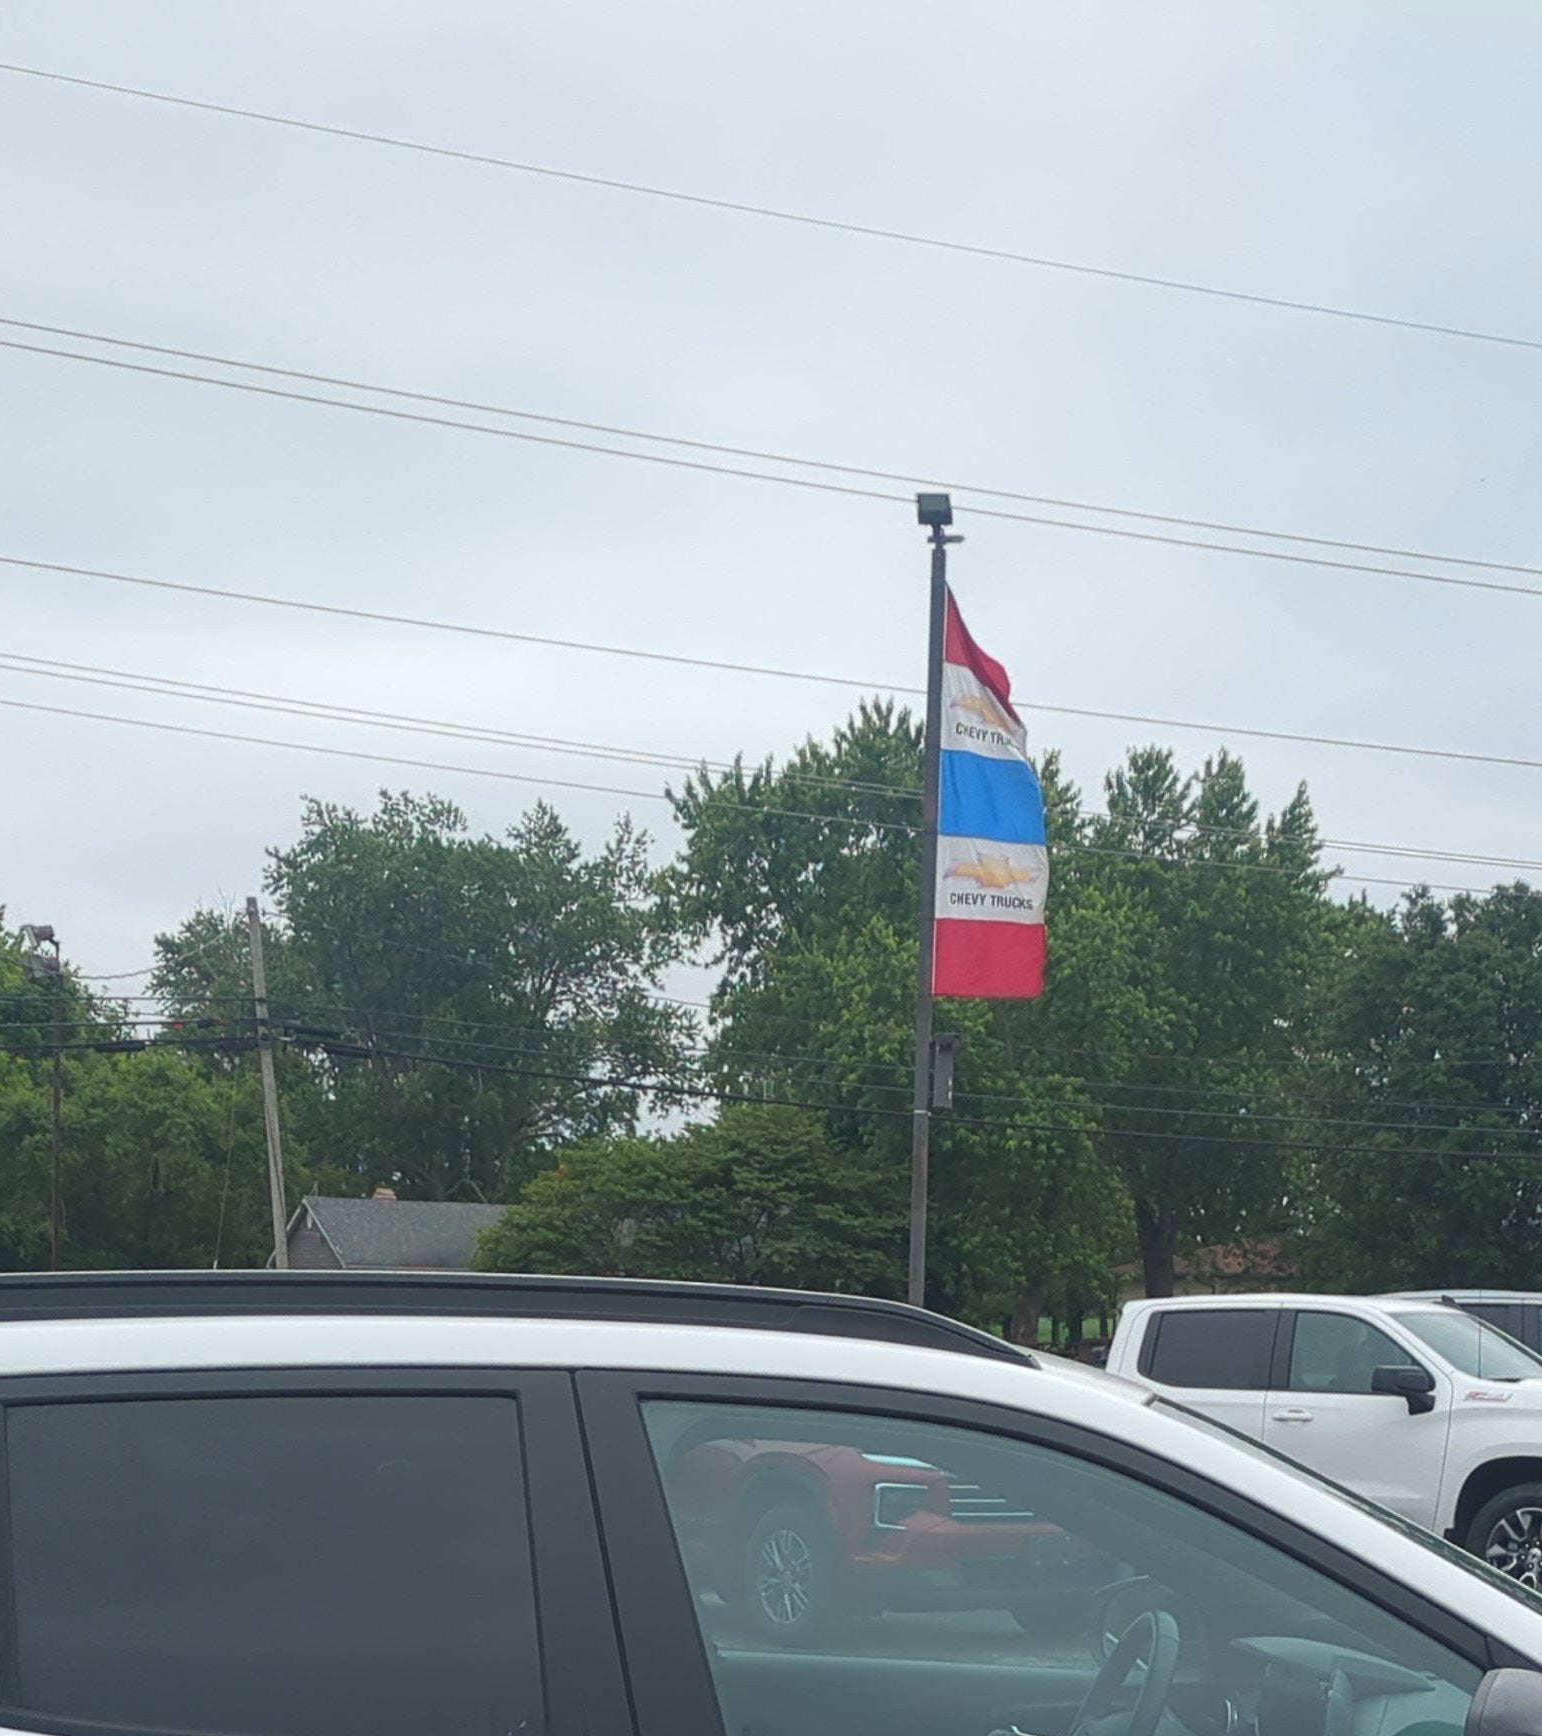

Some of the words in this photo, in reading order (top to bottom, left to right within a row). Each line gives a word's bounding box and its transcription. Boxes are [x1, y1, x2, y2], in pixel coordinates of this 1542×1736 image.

[955, 722, 989, 742] CHEVY
[950, 892, 987, 906] CHEVY
[990, 895, 1034, 910] TRUCKS
